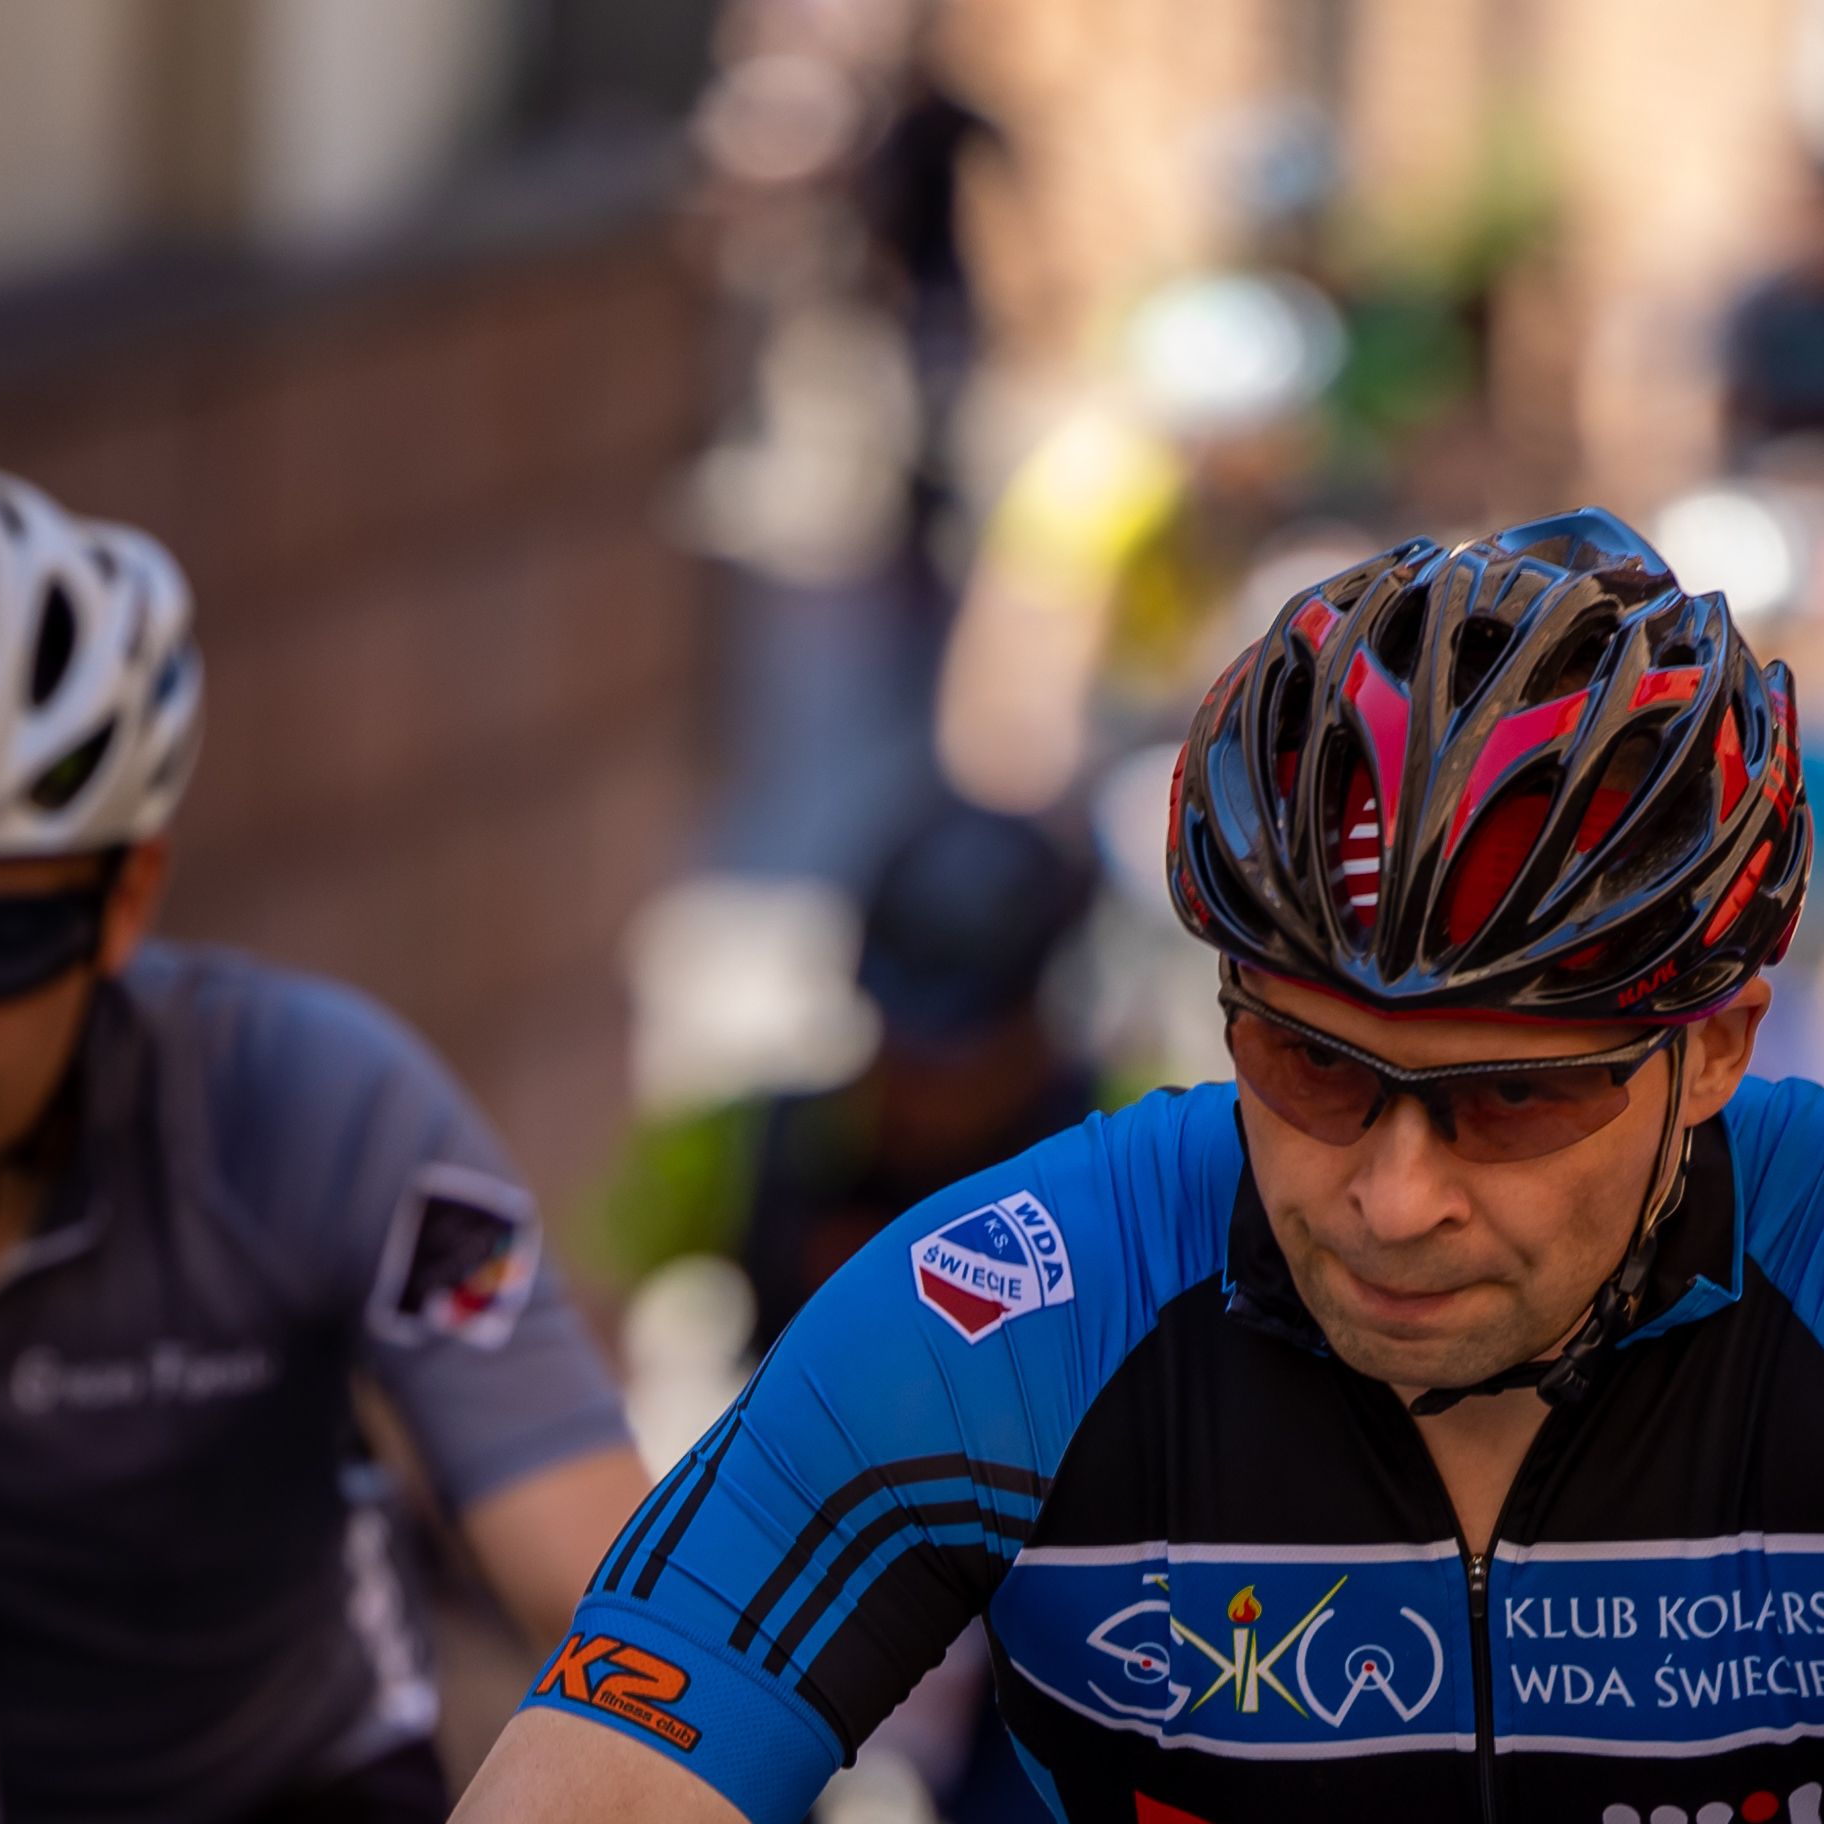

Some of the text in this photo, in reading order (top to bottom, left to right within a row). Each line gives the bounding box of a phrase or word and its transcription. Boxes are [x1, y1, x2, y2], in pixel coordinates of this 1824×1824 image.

[923, 1243, 1022, 1300] ŚWIECIE
[1014, 1201, 1065, 1293] WDA
[1504, 1596, 1639, 1640] KLUB
[533, 1632, 703, 1754] K2
[1511, 1663, 1636, 1708] WDA
